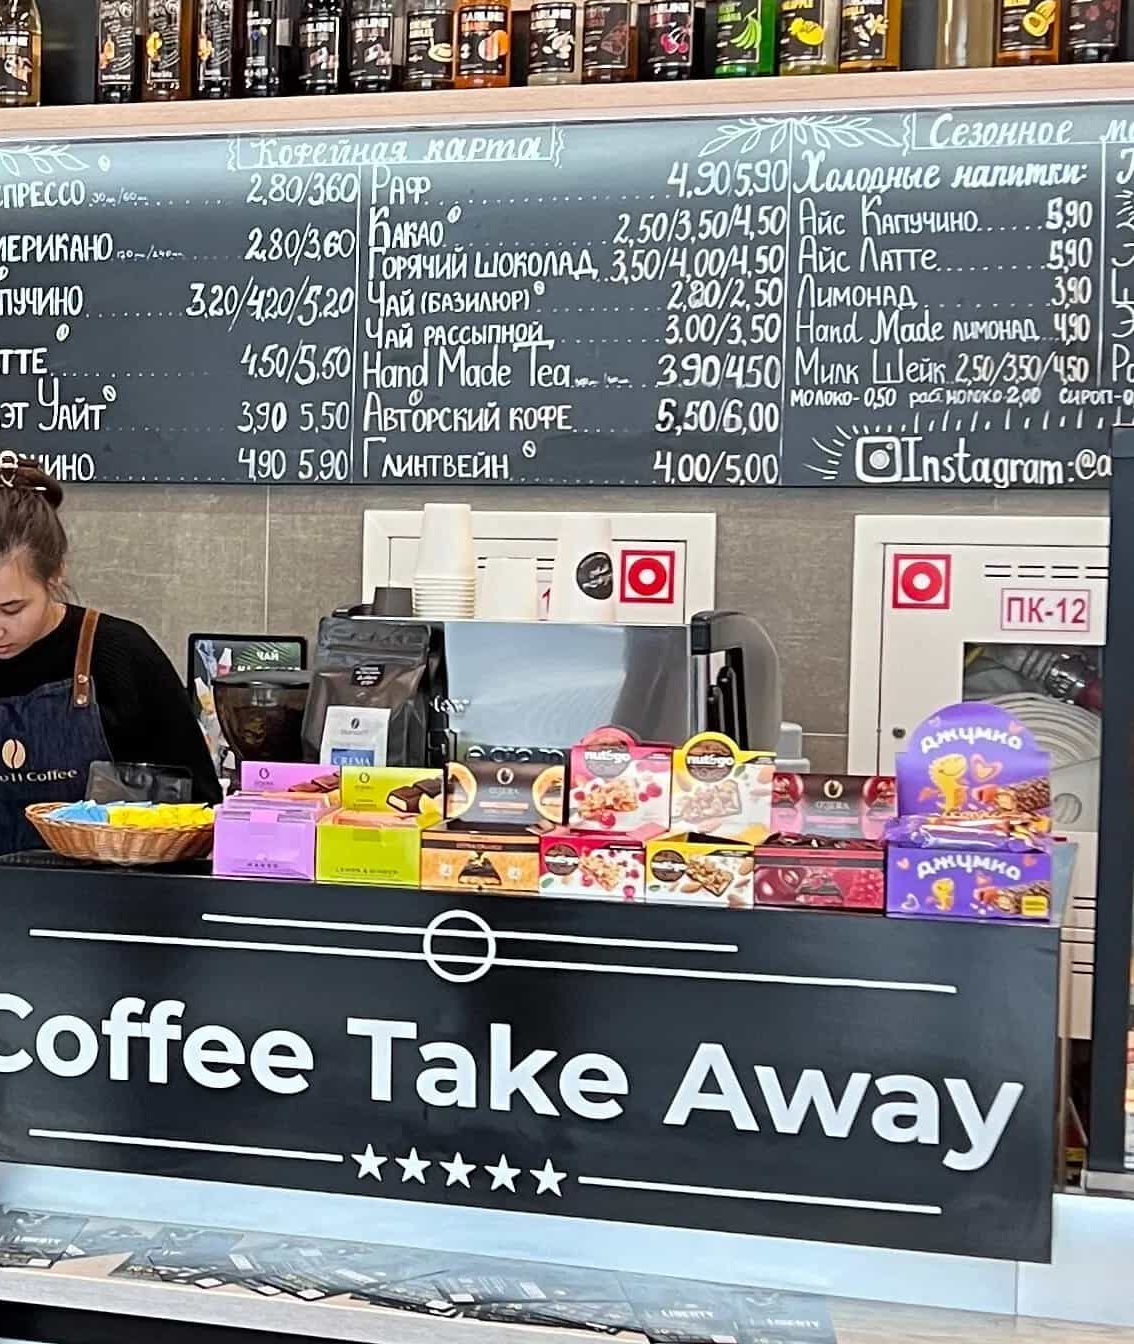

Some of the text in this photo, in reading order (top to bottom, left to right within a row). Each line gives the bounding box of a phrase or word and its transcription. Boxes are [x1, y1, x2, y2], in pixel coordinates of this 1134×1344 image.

[930, 114, 1073, 147] Сезонное
[251, 136, 542, 162] Кофейная карта
[793, 150, 941, 194] Холодные
[796, 310, 862, 344] Hand
[869, 310, 944, 344] Made
[363, 344, 429, 390] Hand
[438, 346, 512, 388] Made
[513, 339, 571, 388] Tea
[1007, 597, 1086, 624] ПК-12
[347, 1016, 629, 1121] Take
[663, 1042, 1024, 1173] Away
